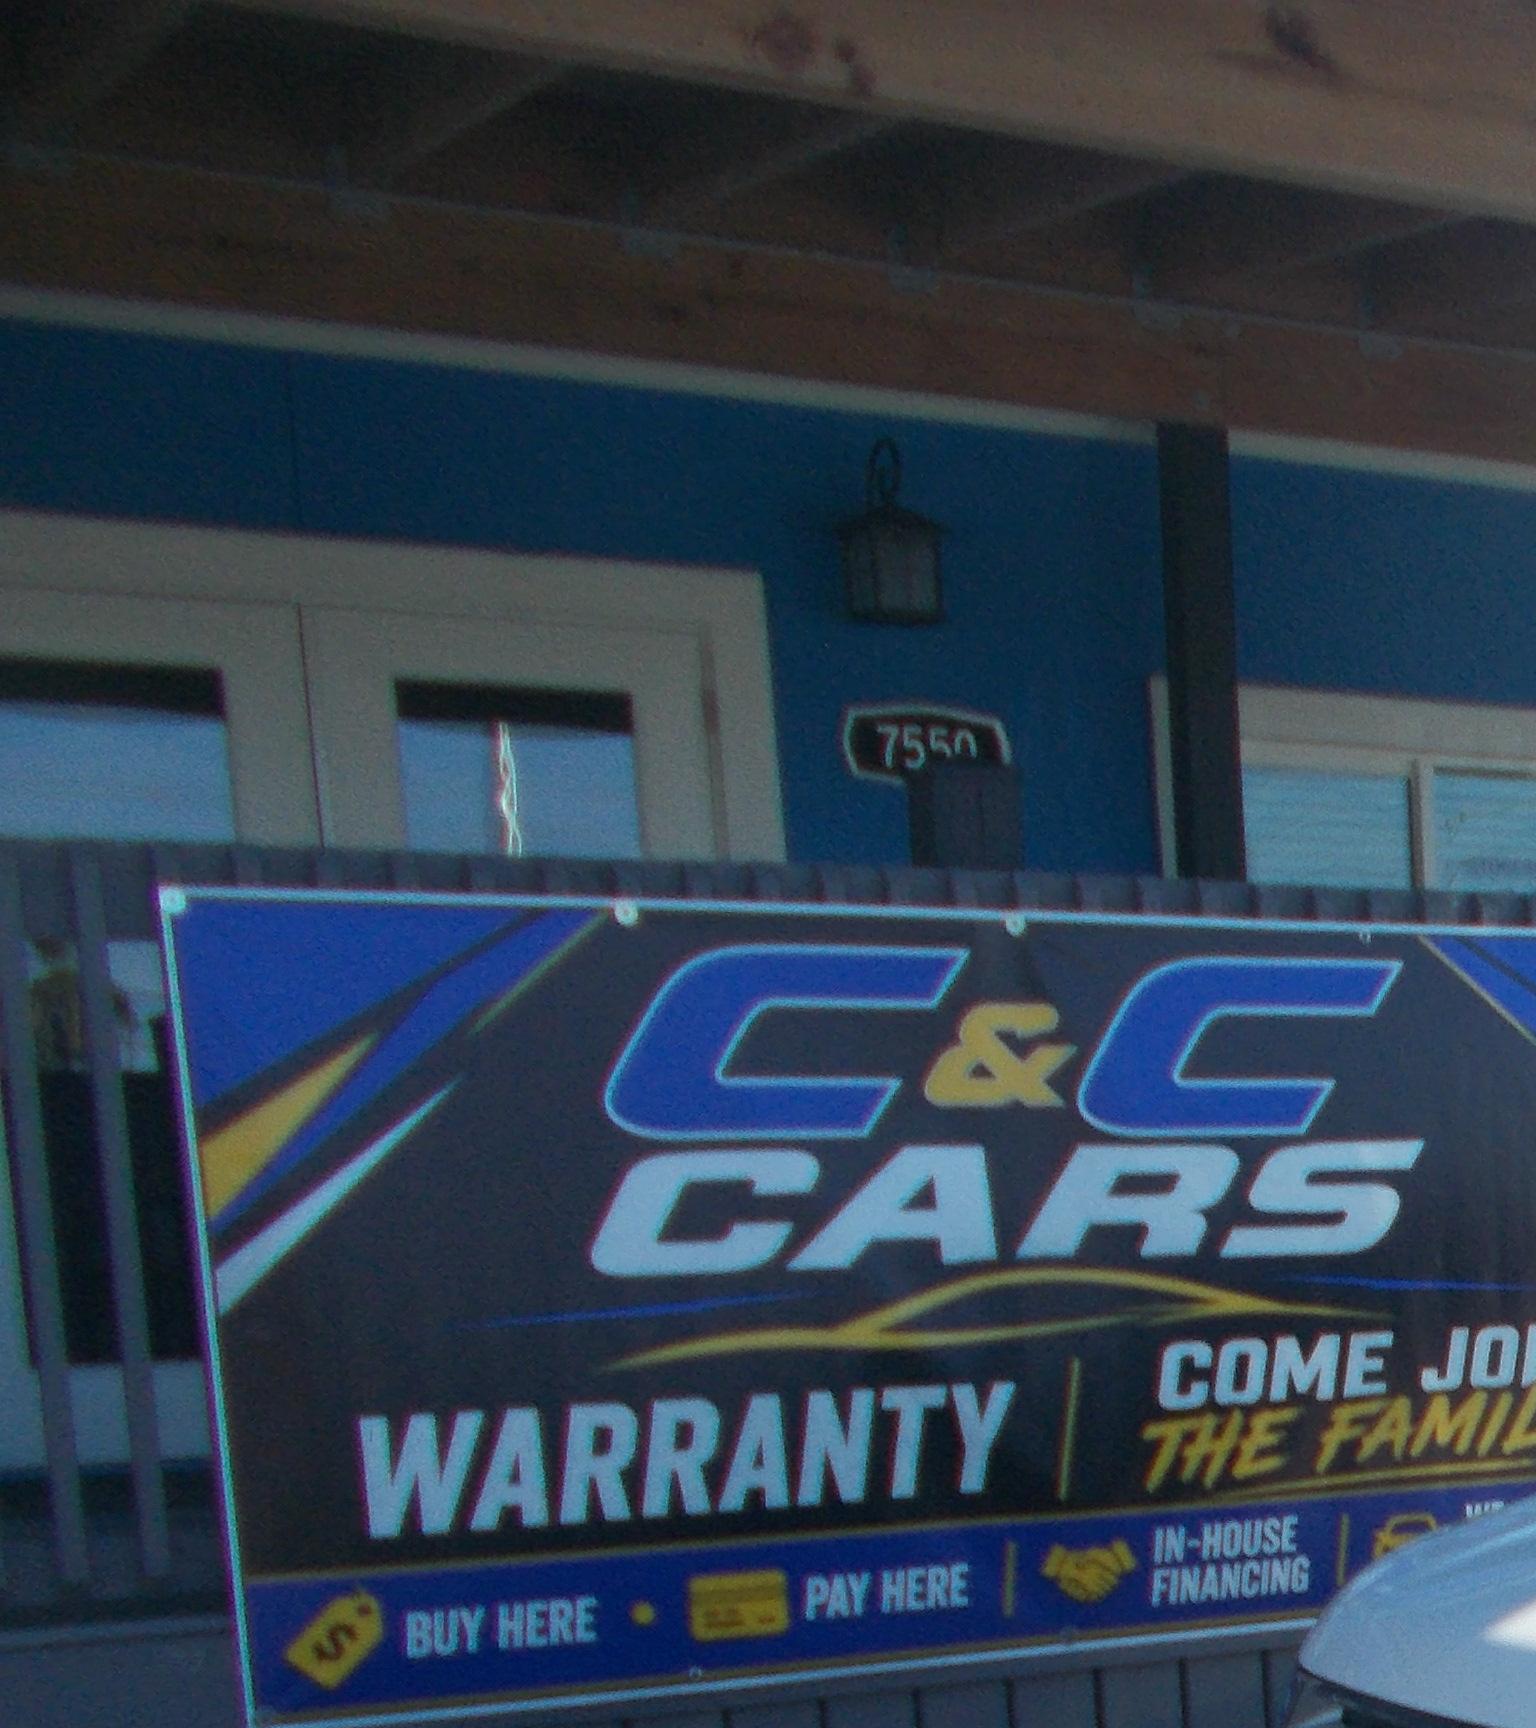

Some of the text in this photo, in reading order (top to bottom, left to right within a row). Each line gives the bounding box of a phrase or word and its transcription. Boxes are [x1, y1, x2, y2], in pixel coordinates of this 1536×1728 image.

[590, 1139, 1425, 1278] CARS
[1157, 1330, 1394, 1411] COME
[359, 1381, 1016, 1540] WARRANTY
[1141, 1406, 1300, 1494] THE
[1152, 1514, 1299, 1566] IN-HOUSE
[804, 1562, 969, 1622] PAY HERE
[1151, 1557, 1311, 1608] FINANCING
[405, 1596, 598, 1658] BUY HERE
